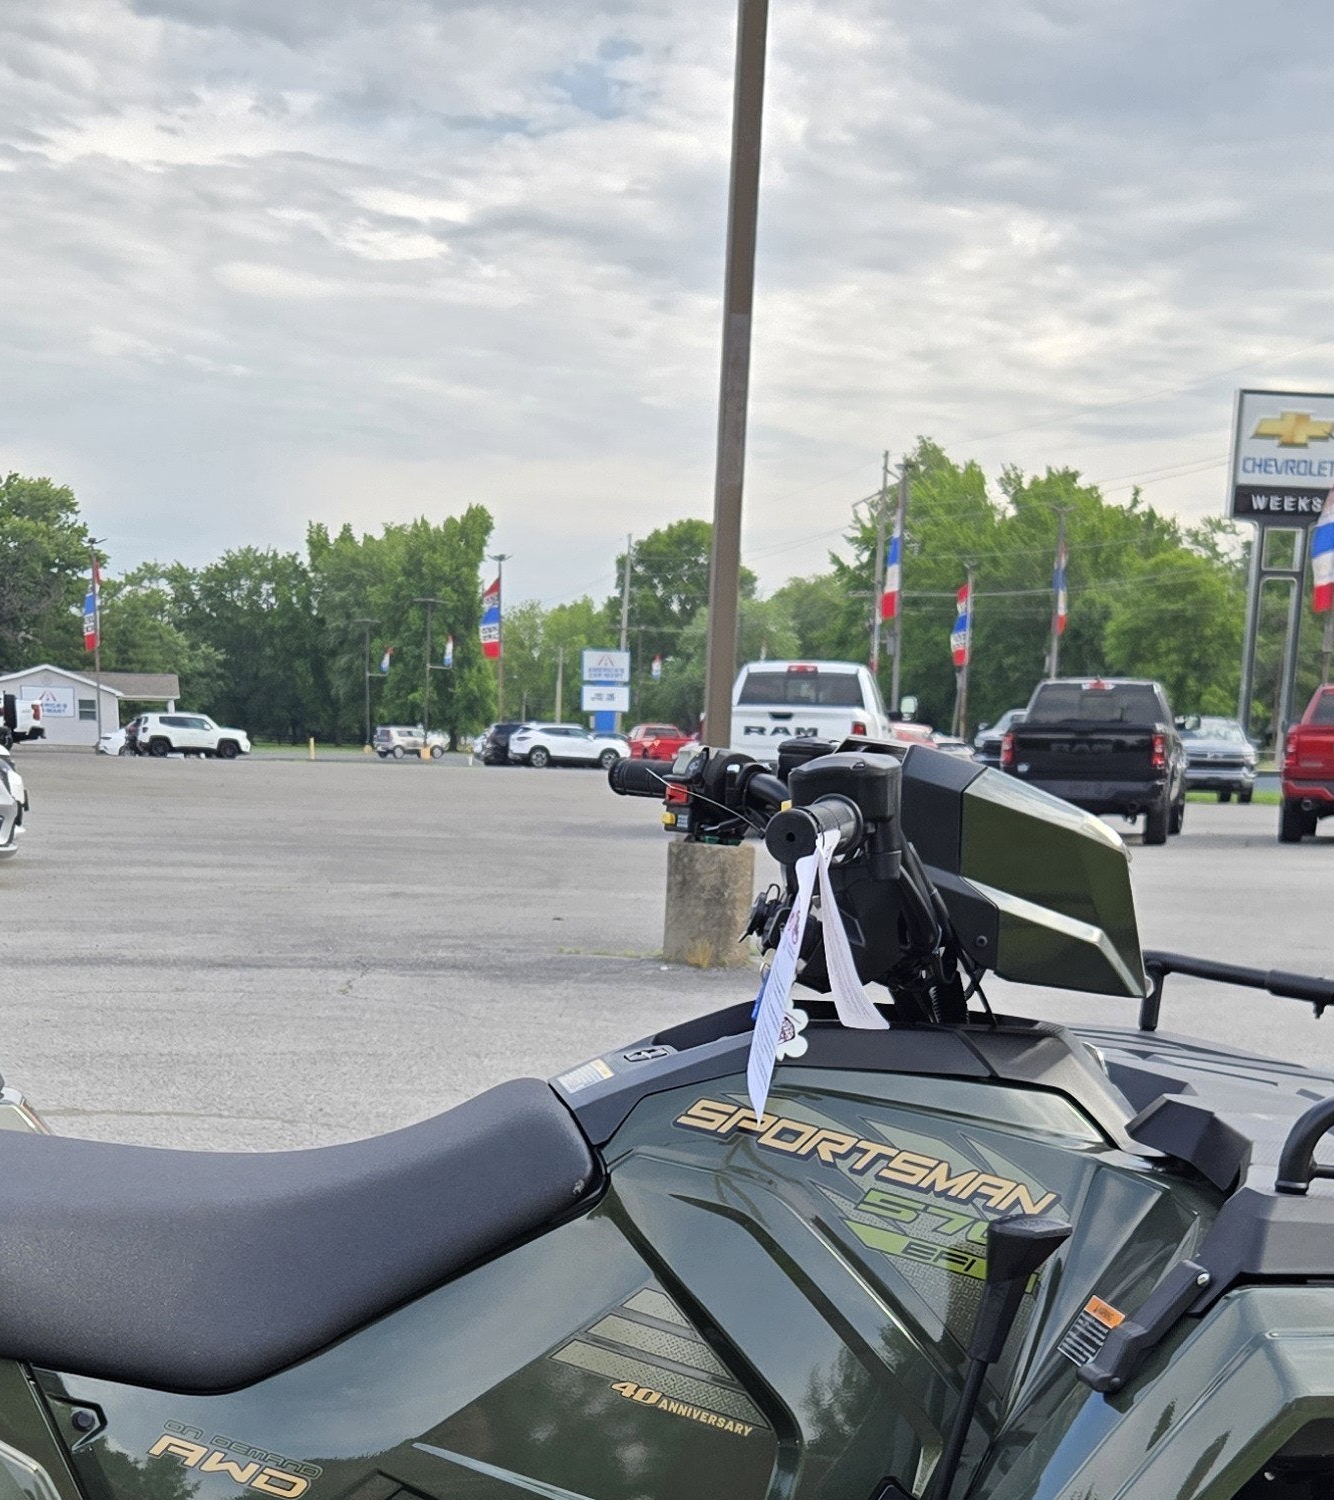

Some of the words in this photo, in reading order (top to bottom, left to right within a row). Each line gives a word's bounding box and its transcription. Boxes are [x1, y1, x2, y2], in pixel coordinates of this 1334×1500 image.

[1251, 494, 1325, 513] WEEKS
[743, 725, 819, 737] RAM
[674, 1098, 1059, 1215] SPORTSMAN
[901, 1241, 977, 1273] EFI
[610, 1381, 664, 1405] 40
[658, 1399, 754, 1437] ANNIVERSARY
[147, 1434, 310, 1500] AWD
[210, 1434, 324, 1480] DEMAND
